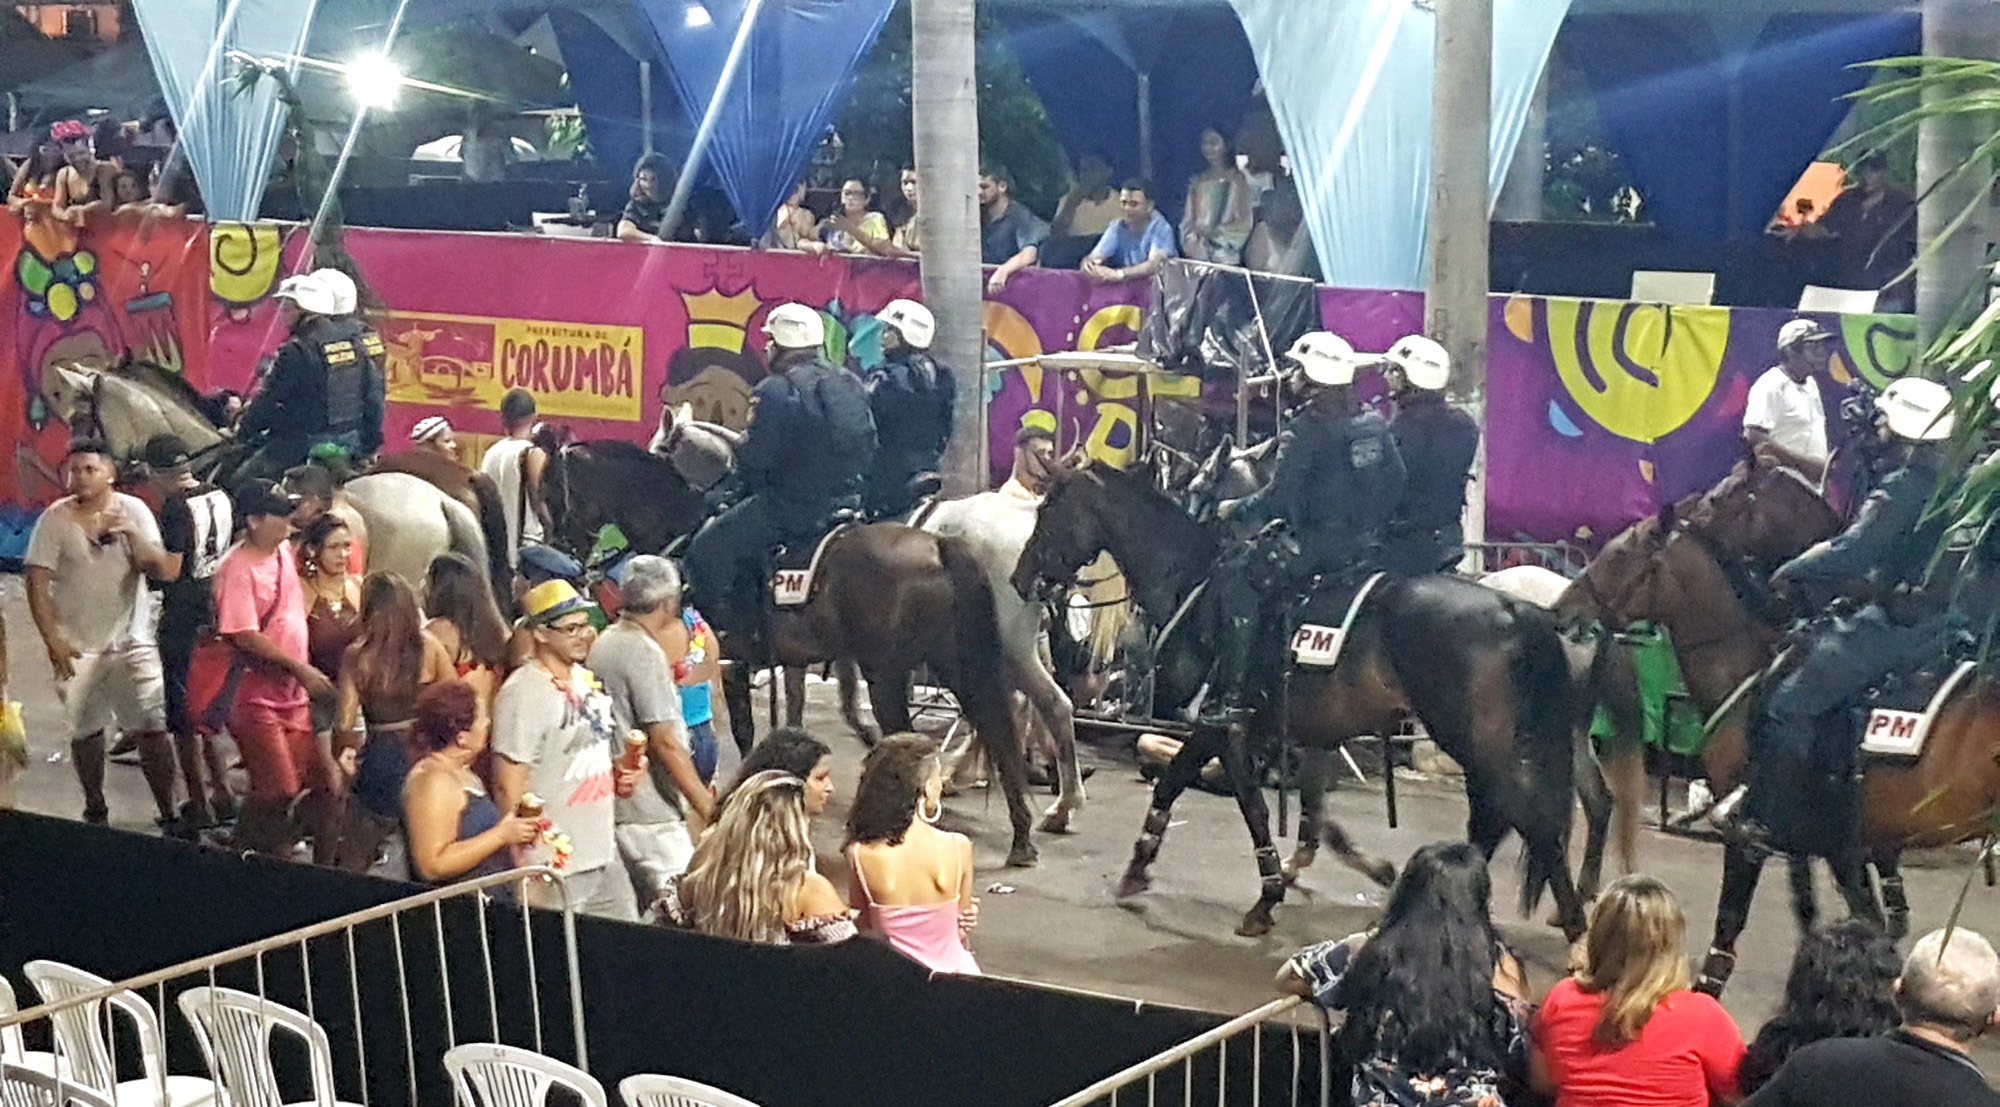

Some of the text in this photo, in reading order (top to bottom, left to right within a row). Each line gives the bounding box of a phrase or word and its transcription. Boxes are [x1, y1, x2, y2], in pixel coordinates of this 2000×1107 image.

[501, 336, 633, 398] CORUMBÁ
[773, 574, 804, 592] PM
[1296, 629, 1335, 652] PM
[1871, 714, 1918, 738] PM
